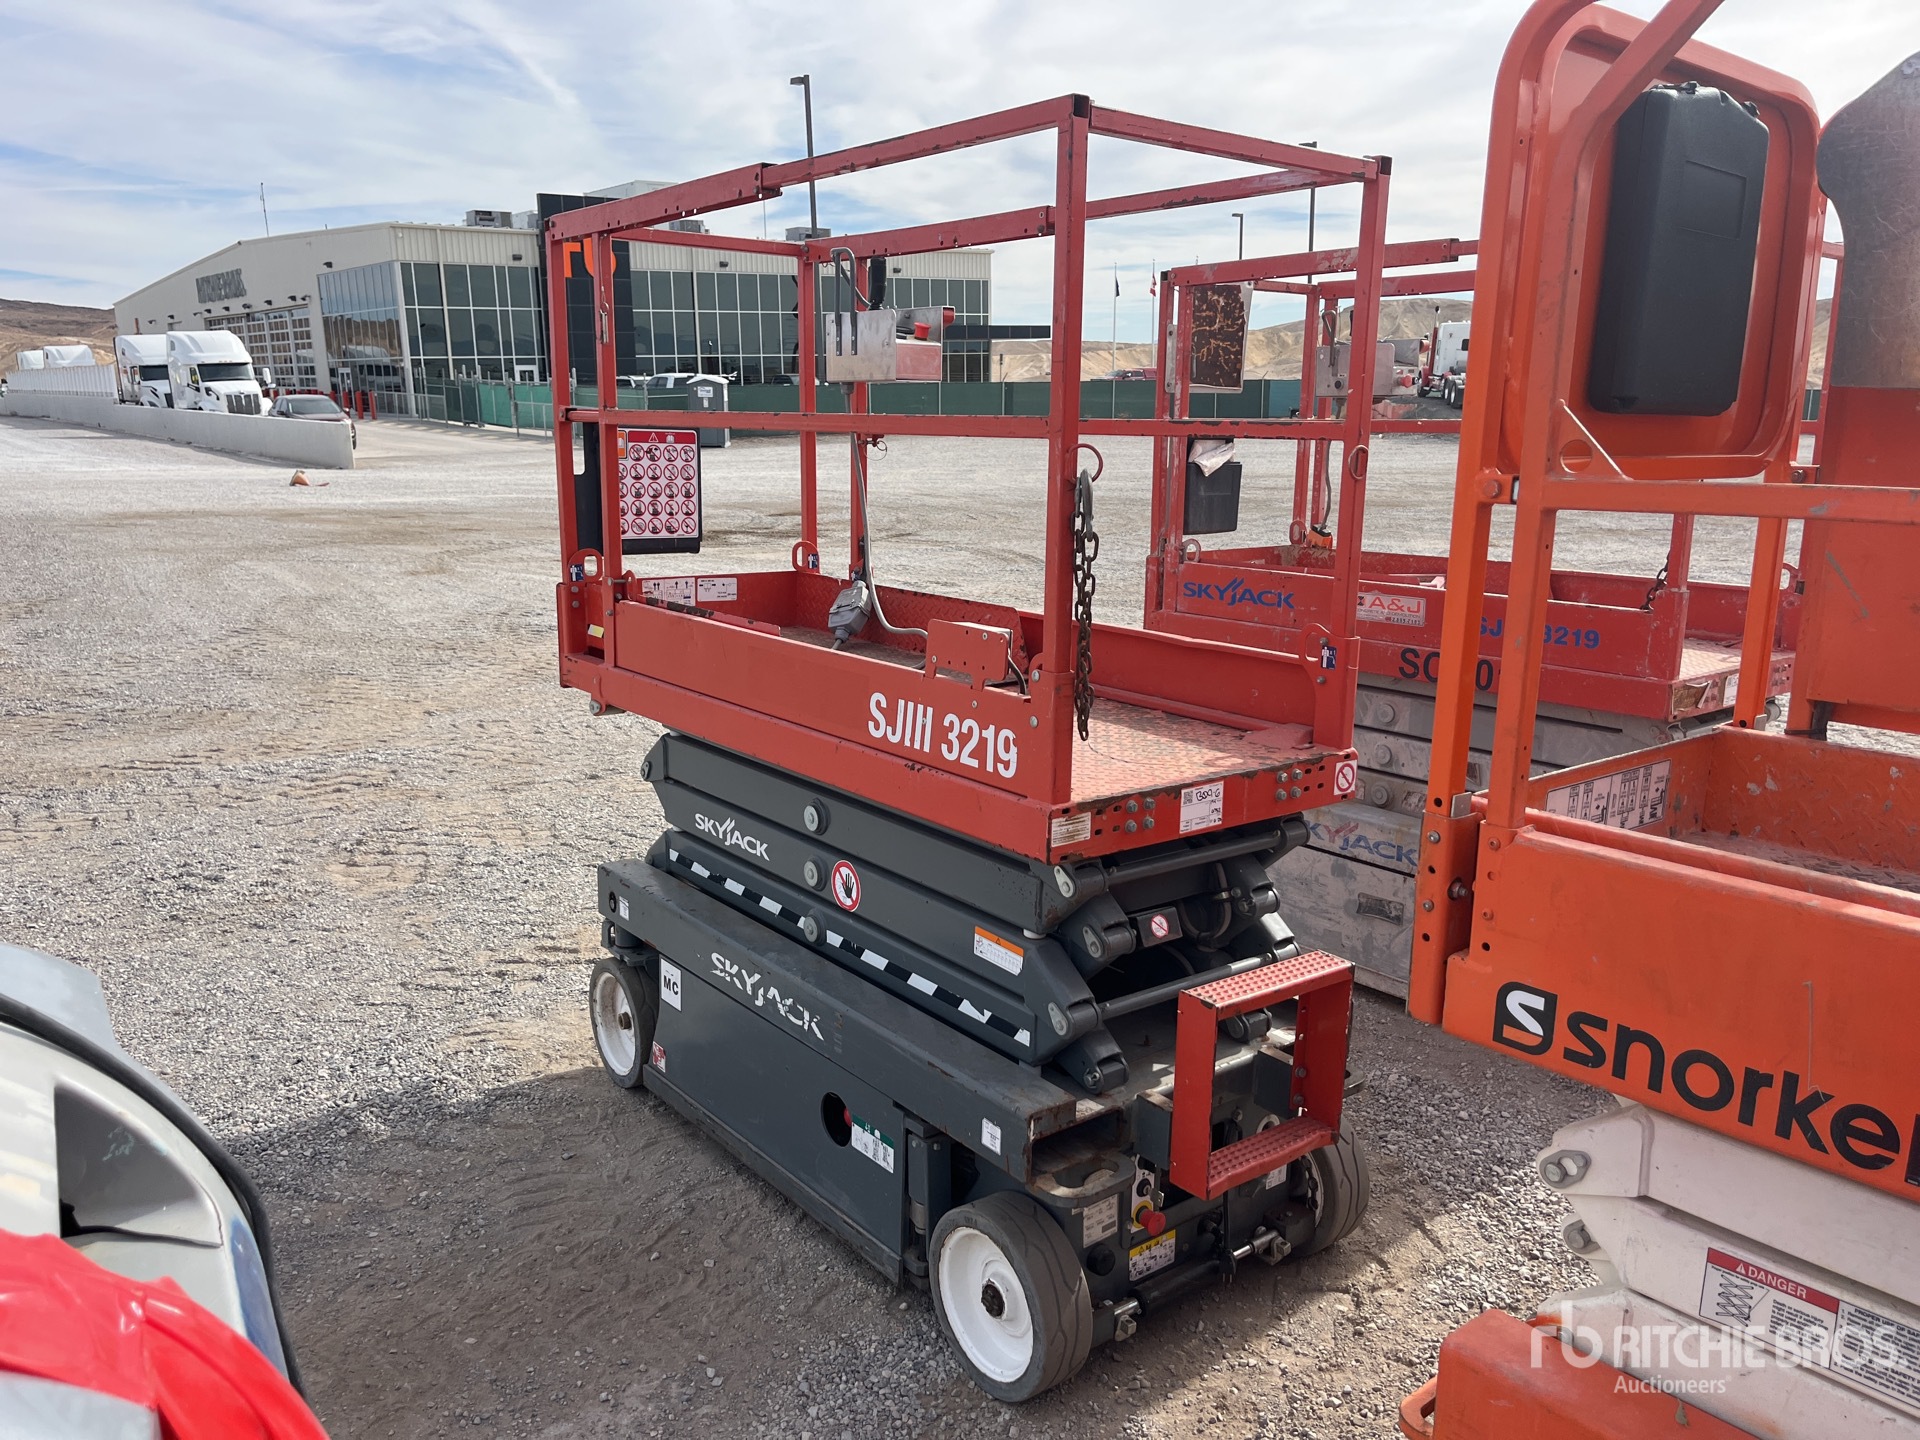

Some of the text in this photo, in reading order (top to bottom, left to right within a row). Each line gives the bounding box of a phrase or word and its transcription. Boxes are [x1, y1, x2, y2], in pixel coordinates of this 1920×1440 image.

[1183, 577, 1295, 609] SKYJACK
[1369, 597, 1420, 613] A&J
[941, 713, 1018, 778] 3219
[695, 813, 770, 861] SKYJACK
[1305, 821, 1417, 867] KYJACK
[663, 975, 679, 996] MC
[710, 952, 824, 1041] SKYJACK
[1748, 1266, 1807, 1299] DANGER
